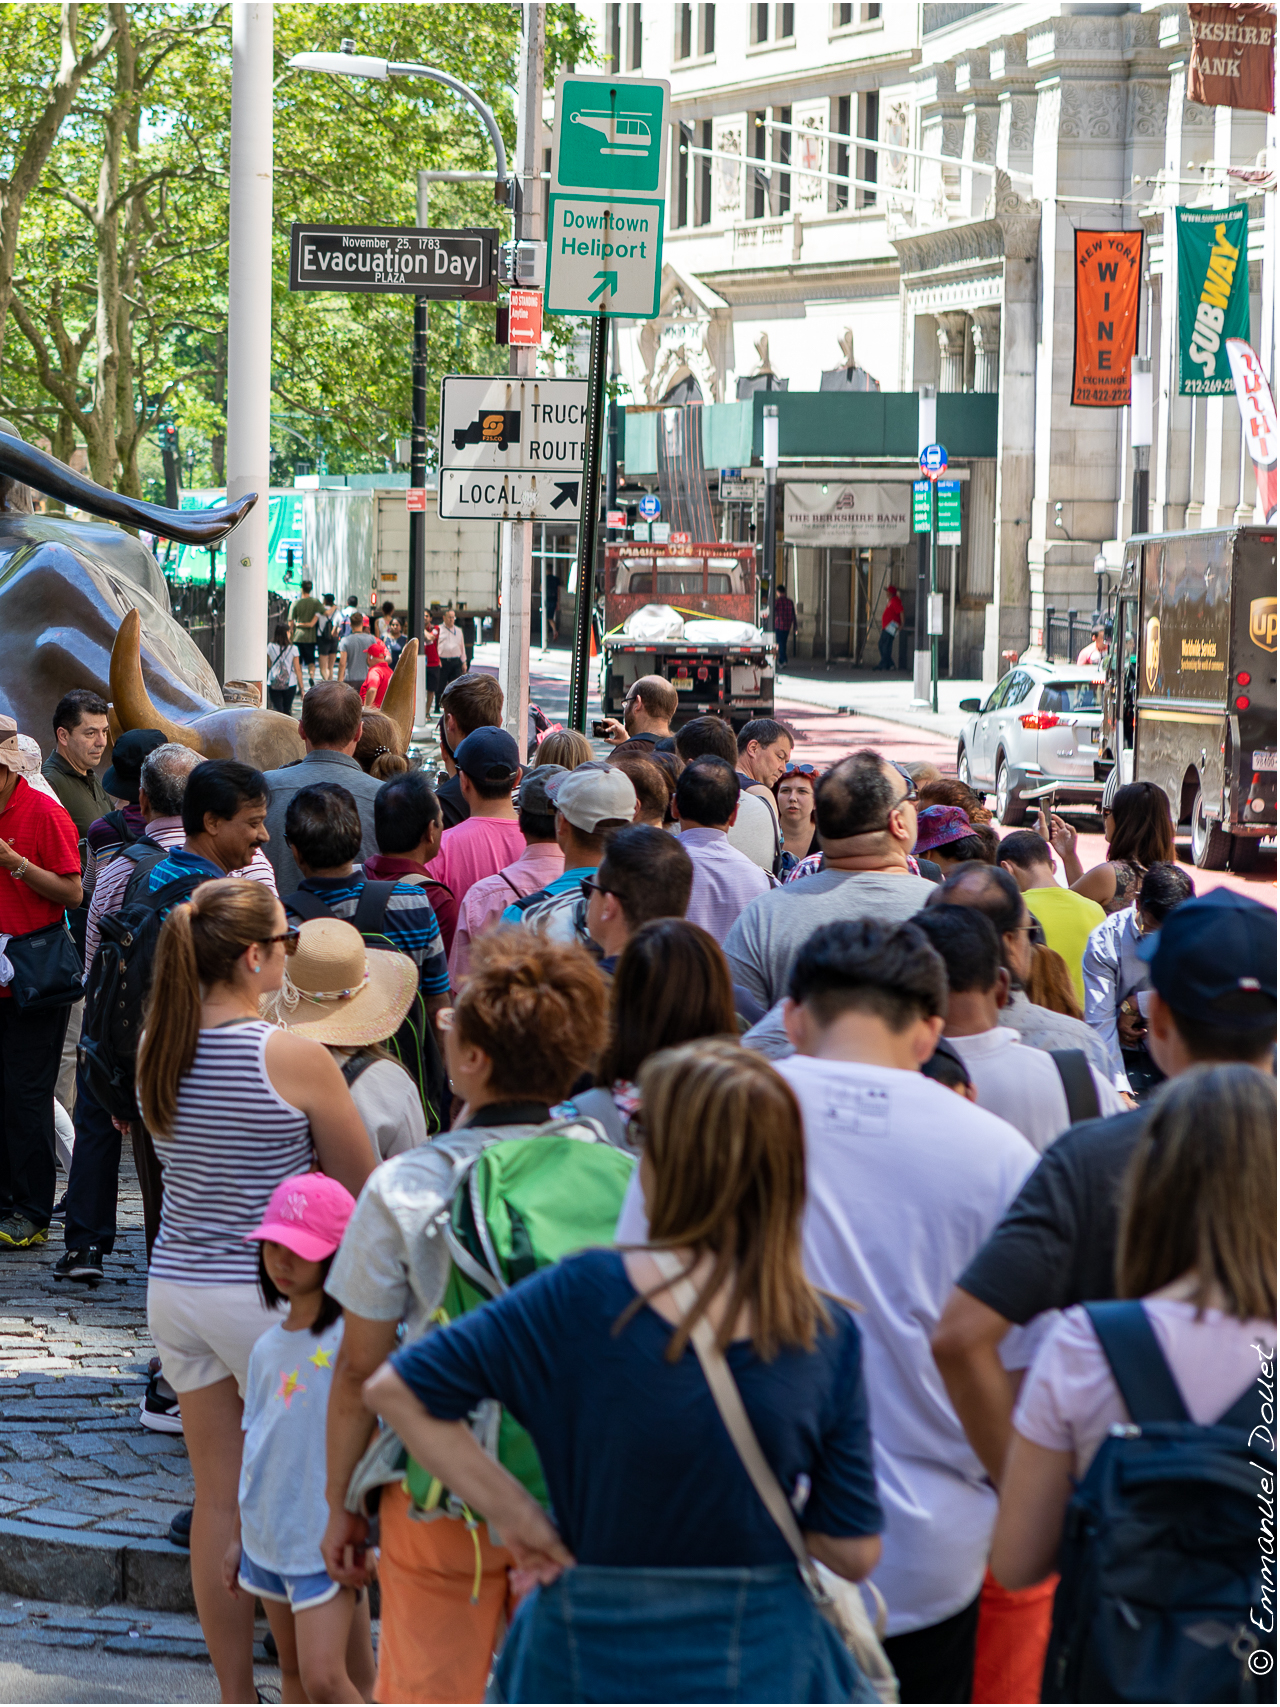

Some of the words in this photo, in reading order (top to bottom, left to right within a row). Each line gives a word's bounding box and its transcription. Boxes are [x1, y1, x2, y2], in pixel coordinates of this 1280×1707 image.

[1198, 55, 1241, 77] ANK
[563, 209, 649, 233] Downtown
[342, 236, 390, 249] November
[418, 238, 440, 250] 1783
[561, 237, 647, 260] Heliport
[303, 245, 428, 274] Evacuation
[434, 249, 477, 282] Day
[1079, 240, 1103, 268] NEW
[1107, 239, 1137, 268] YORK
[375, 272, 406, 284] PLAZA
[511, 295, 518, 306] NO
[519, 295, 538, 307] STANDING
[1189, 222, 1240, 379] SUBWAY
[1097, 262, 1119, 370] WINE
[1082, 376, 1127, 385] EXCHANGE
[531, 404, 587, 424] TRUCK
[459, 484, 522, 504] LOCAL
[788, 513, 810, 523] THE
[812, 513, 874, 523] BERKSHIRE
[876, 513, 907, 523] BANK
[674, 534, 686, 543] 34
